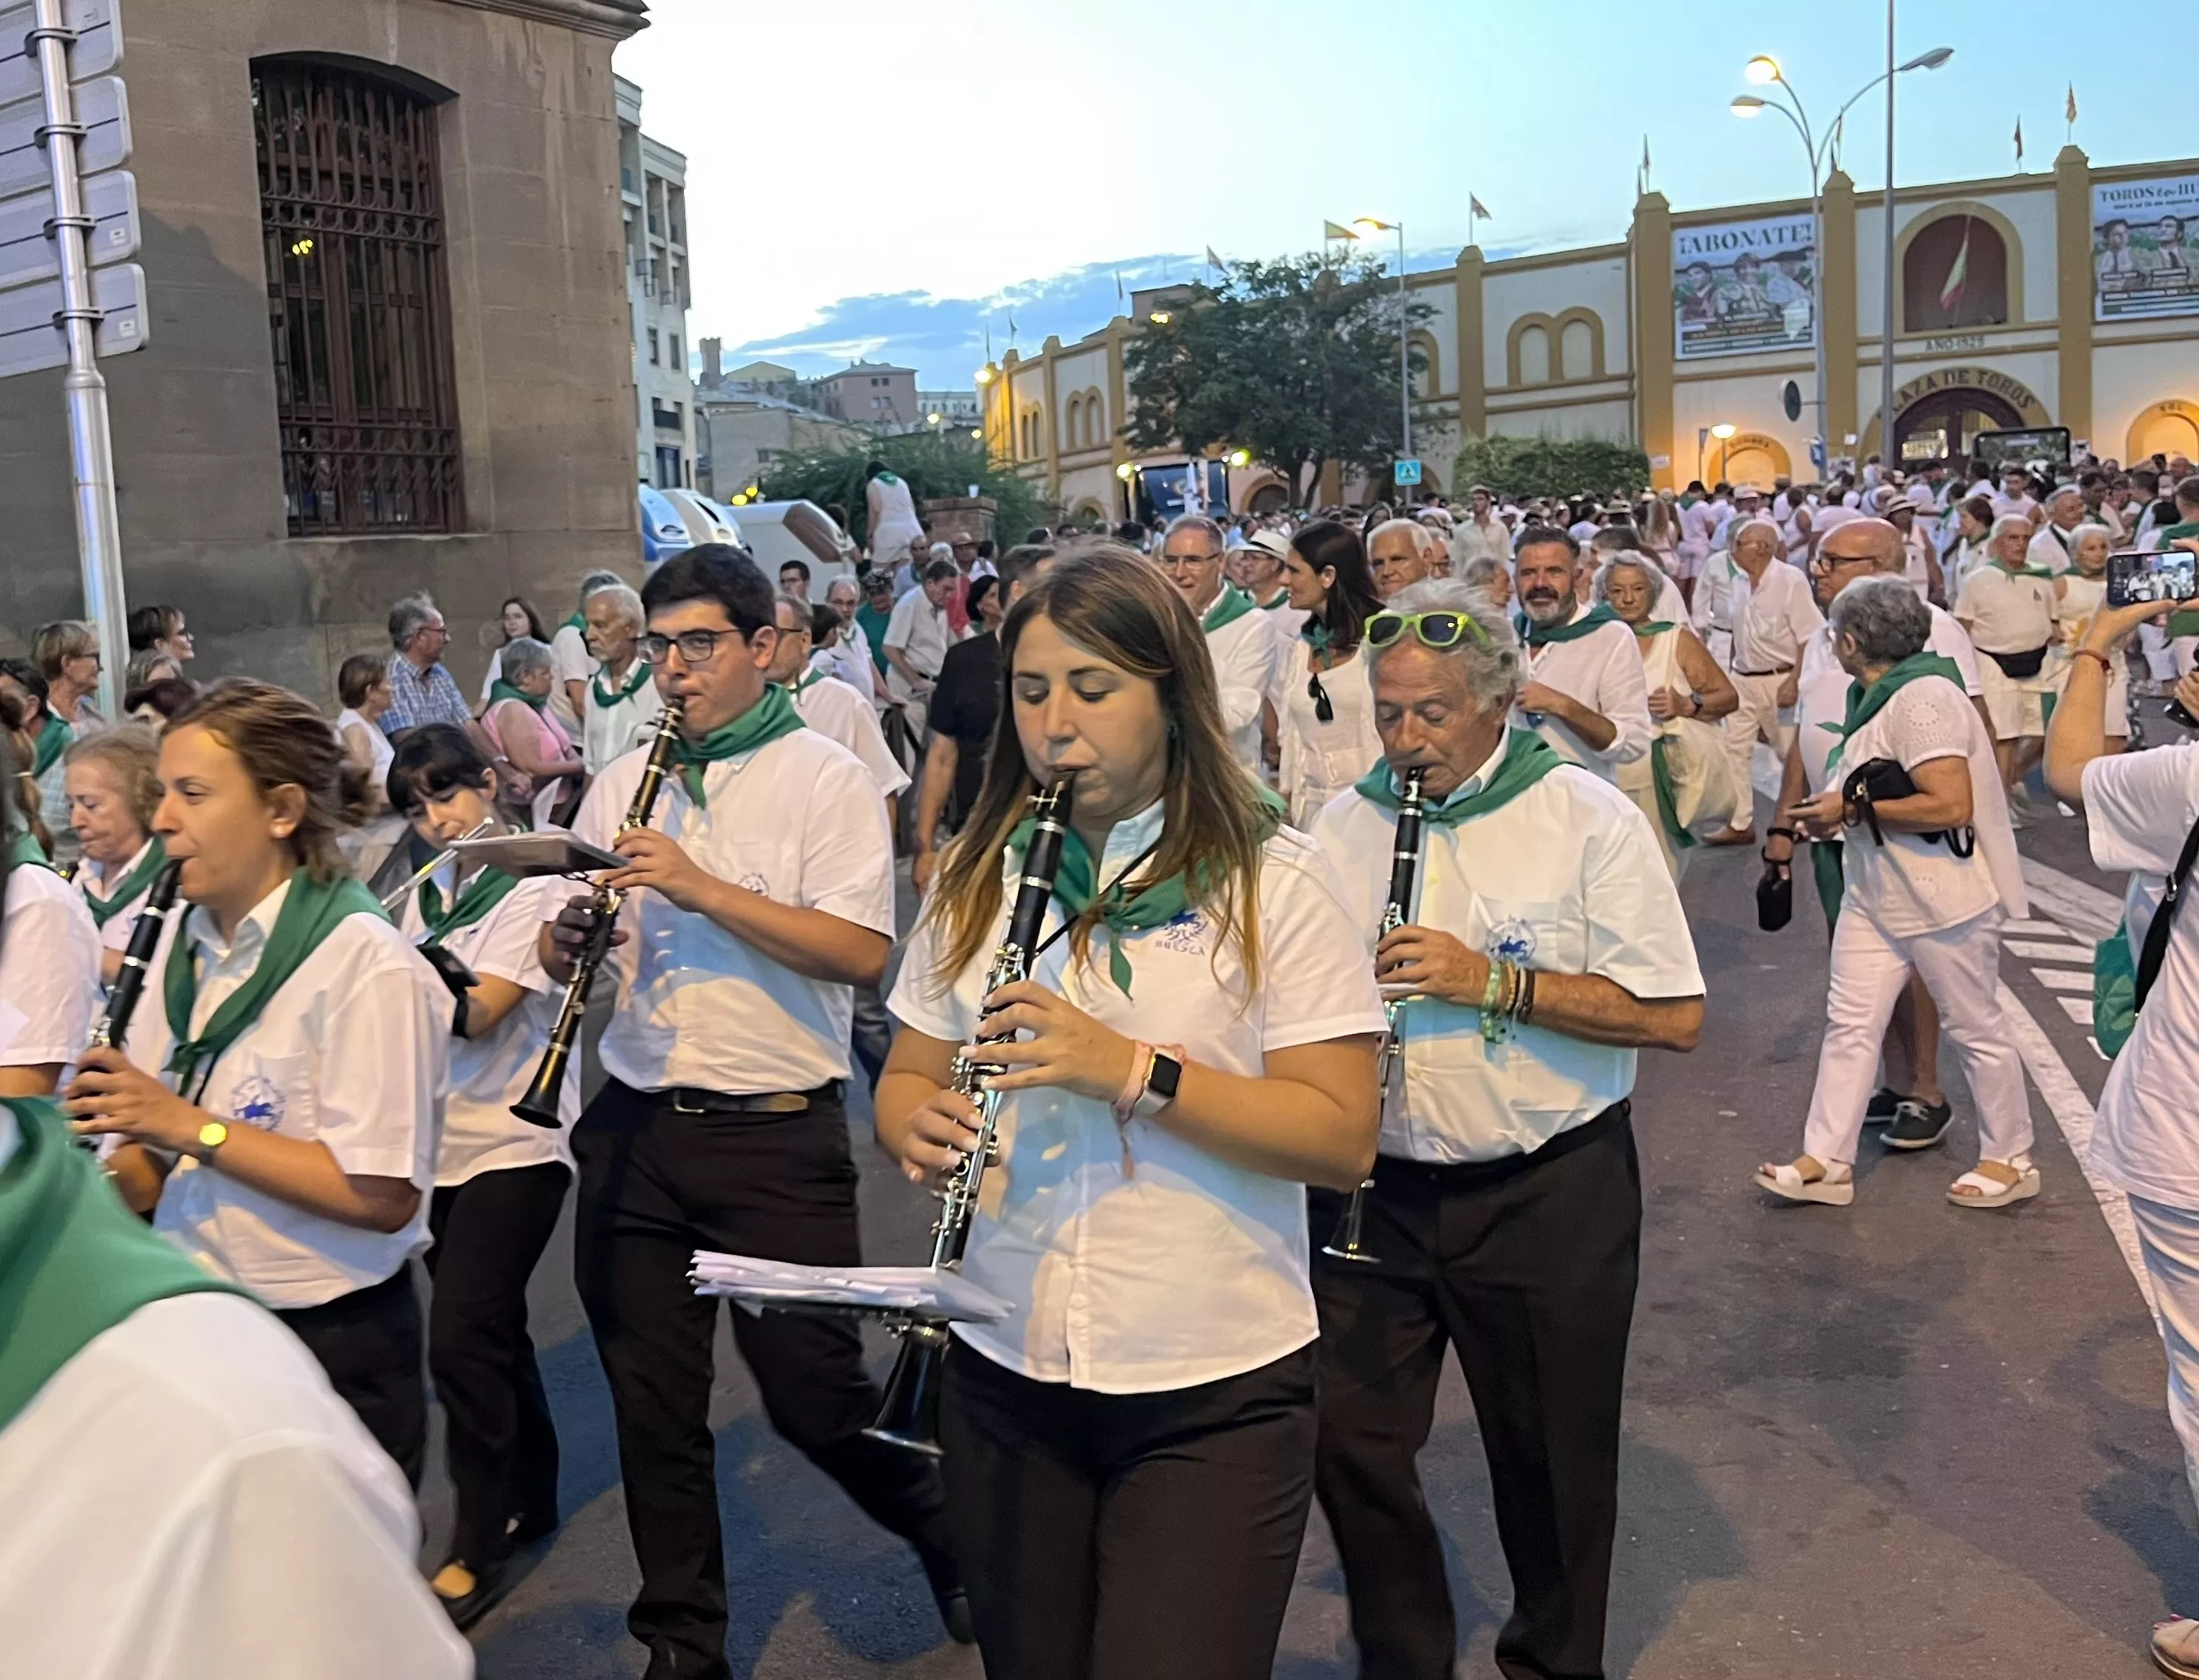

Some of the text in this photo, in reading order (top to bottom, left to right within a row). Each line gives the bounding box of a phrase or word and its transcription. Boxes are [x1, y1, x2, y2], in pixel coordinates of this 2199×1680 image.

[2100, 186, 2155, 202] TOROS
[1943, 369, 1970, 385] DE
[1976, 369, 2037, 409] TOROS
